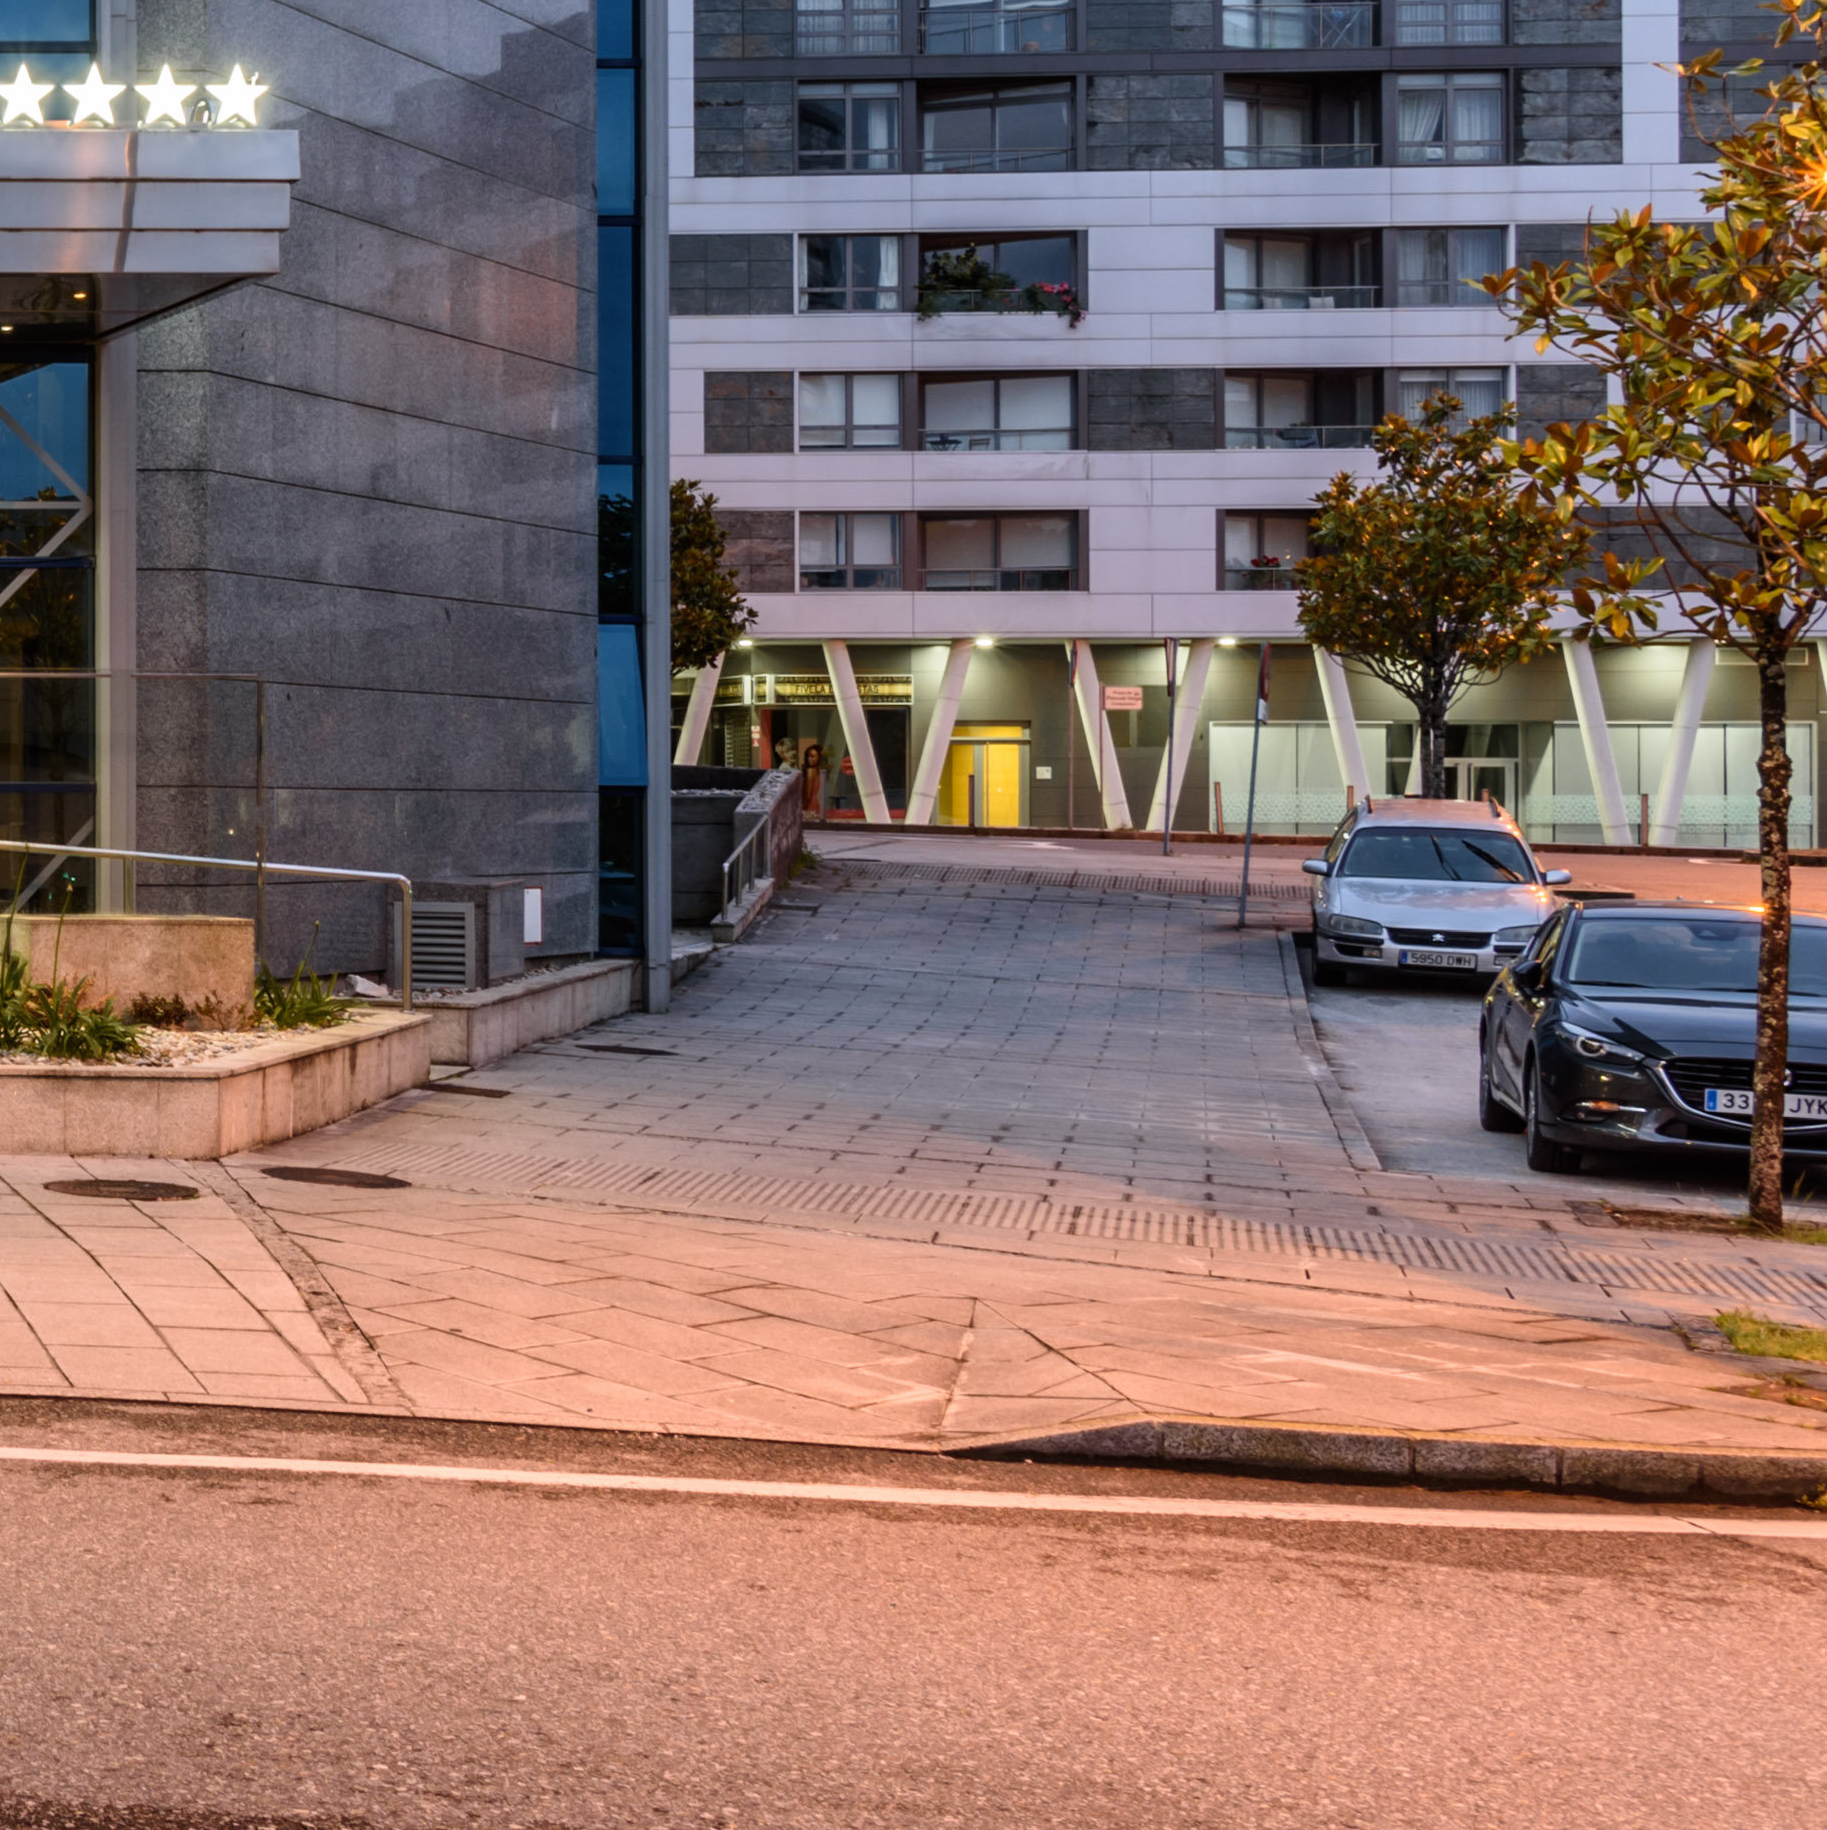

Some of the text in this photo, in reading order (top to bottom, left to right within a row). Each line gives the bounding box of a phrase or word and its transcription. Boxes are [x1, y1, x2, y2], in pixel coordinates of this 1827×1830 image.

[796, 684, 826, 695] FIVELA
[1411, 952, 1443, 965] 5950
[1723, 1093, 1827, 1115] 33 JYK
